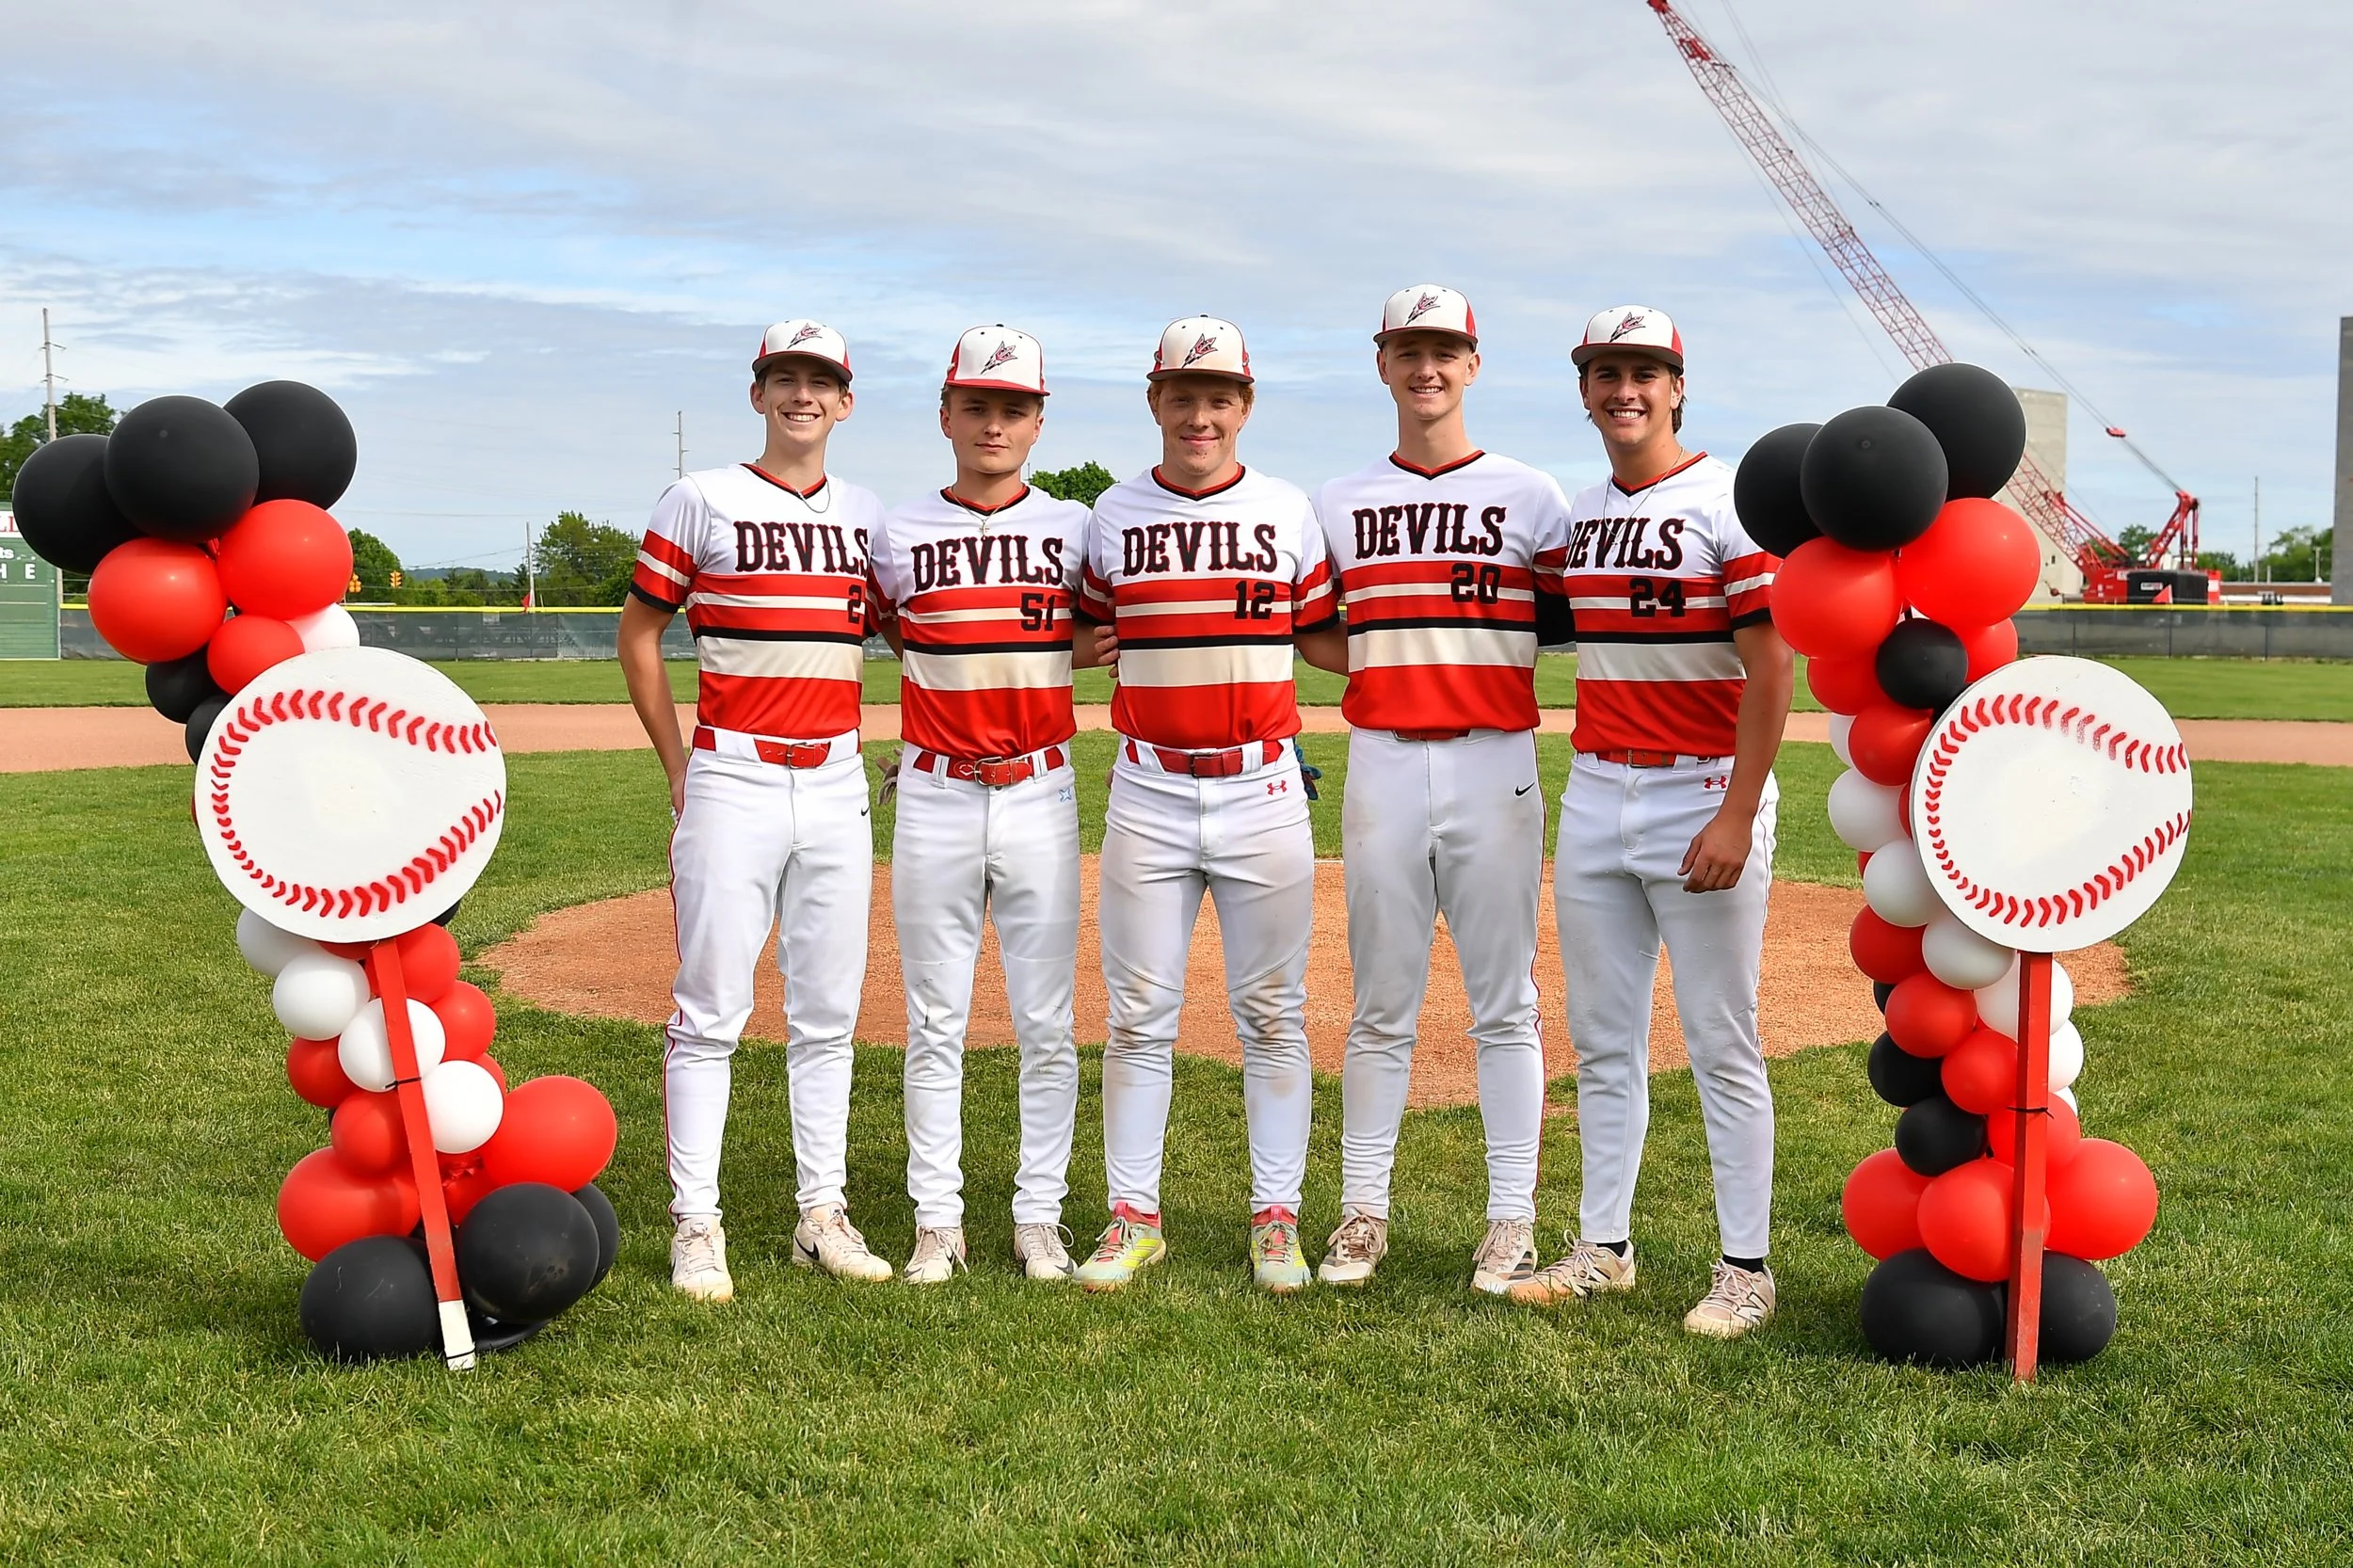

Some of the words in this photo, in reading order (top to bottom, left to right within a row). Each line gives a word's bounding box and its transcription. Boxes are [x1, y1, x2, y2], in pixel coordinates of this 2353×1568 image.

[733, 520, 869, 578] DEVILS
[1122, 521, 1277, 577] DEVILS
[1352, 502, 1507, 560] DEVILS
[1563, 517, 1687, 571] DEVILS
[24, 563, 36, 580] E
[910, 535, 1064, 593] DEVILS
[1450, 562, 1501, 604] 20
[1020, 592, 1057, 632] 51
[1234, 580, 1275, 620] 12
[1629, 577, 1686, 617] 24
